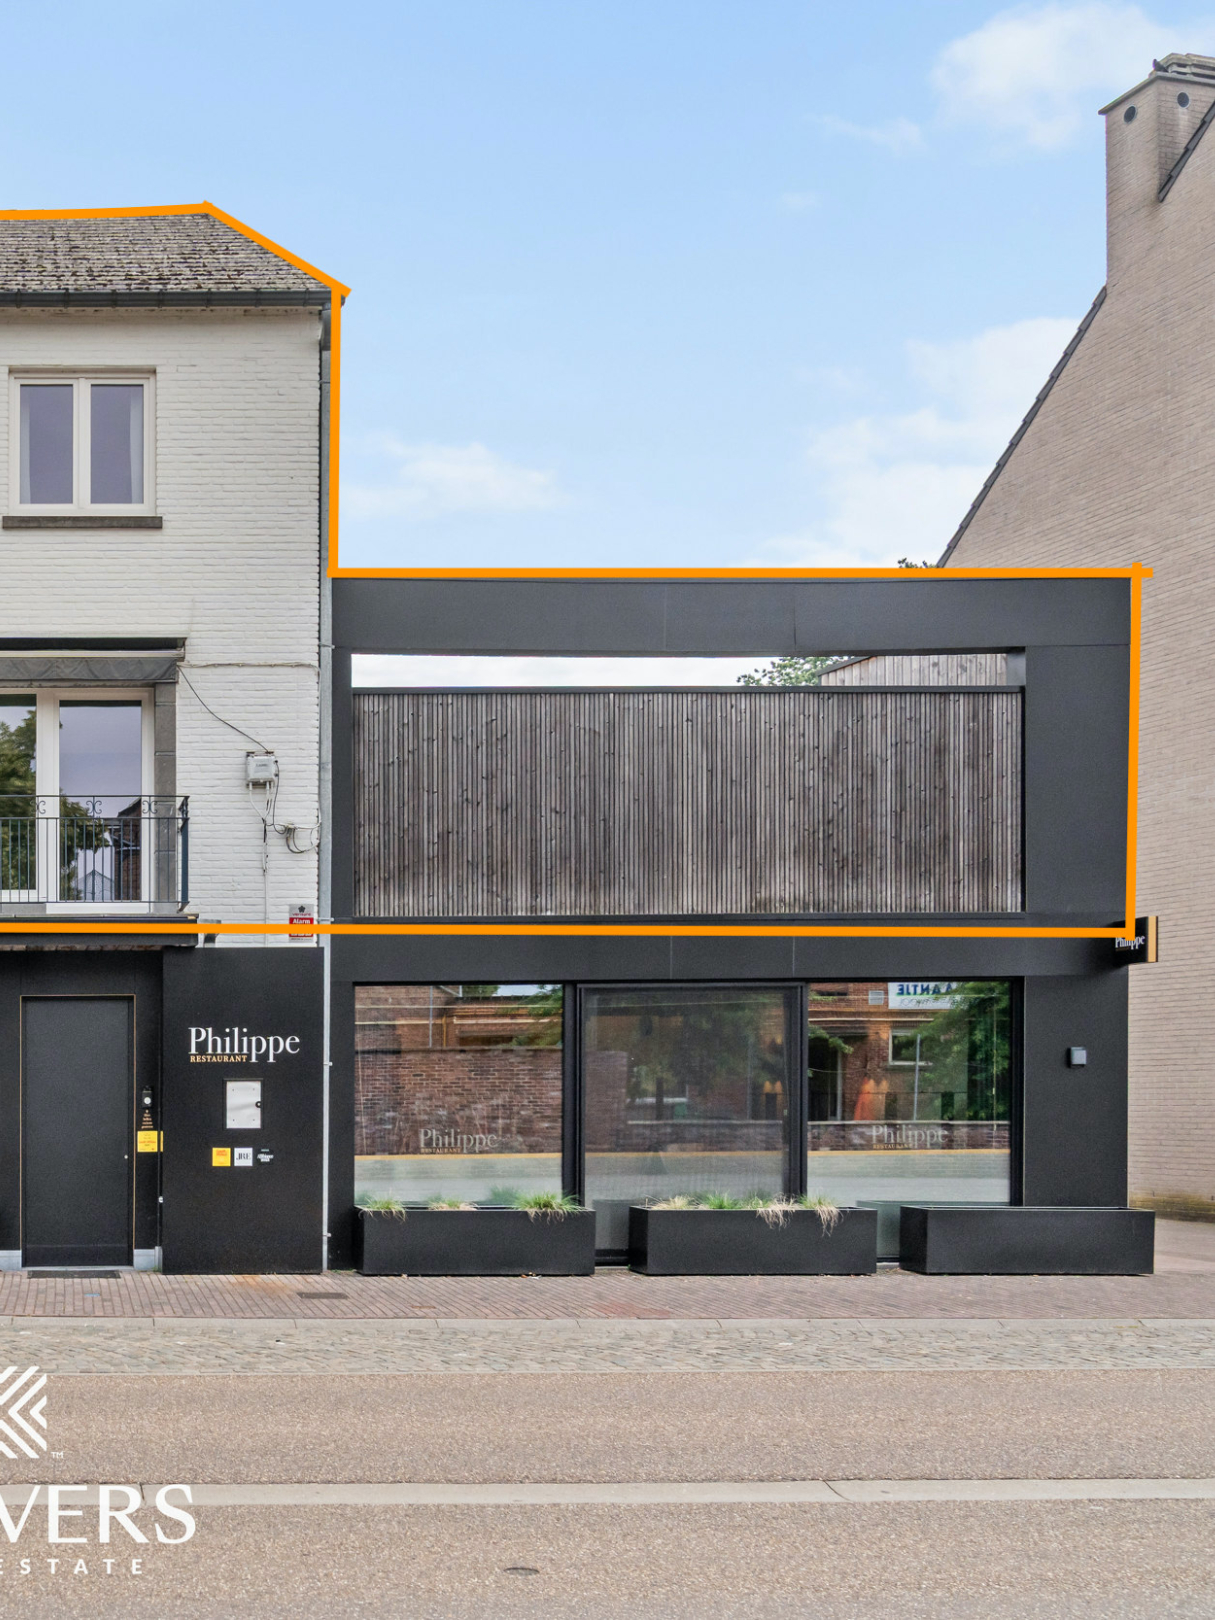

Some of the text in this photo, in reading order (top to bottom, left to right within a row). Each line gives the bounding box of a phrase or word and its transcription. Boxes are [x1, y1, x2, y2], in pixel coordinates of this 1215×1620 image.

[187, 1027, 300, 1063] Philippe
[189, 1055, 248, 1063] RESTAURANT
[418, 1128, 499, 1154] Philippe
[871, 1124, 949, 1149] Philippe
